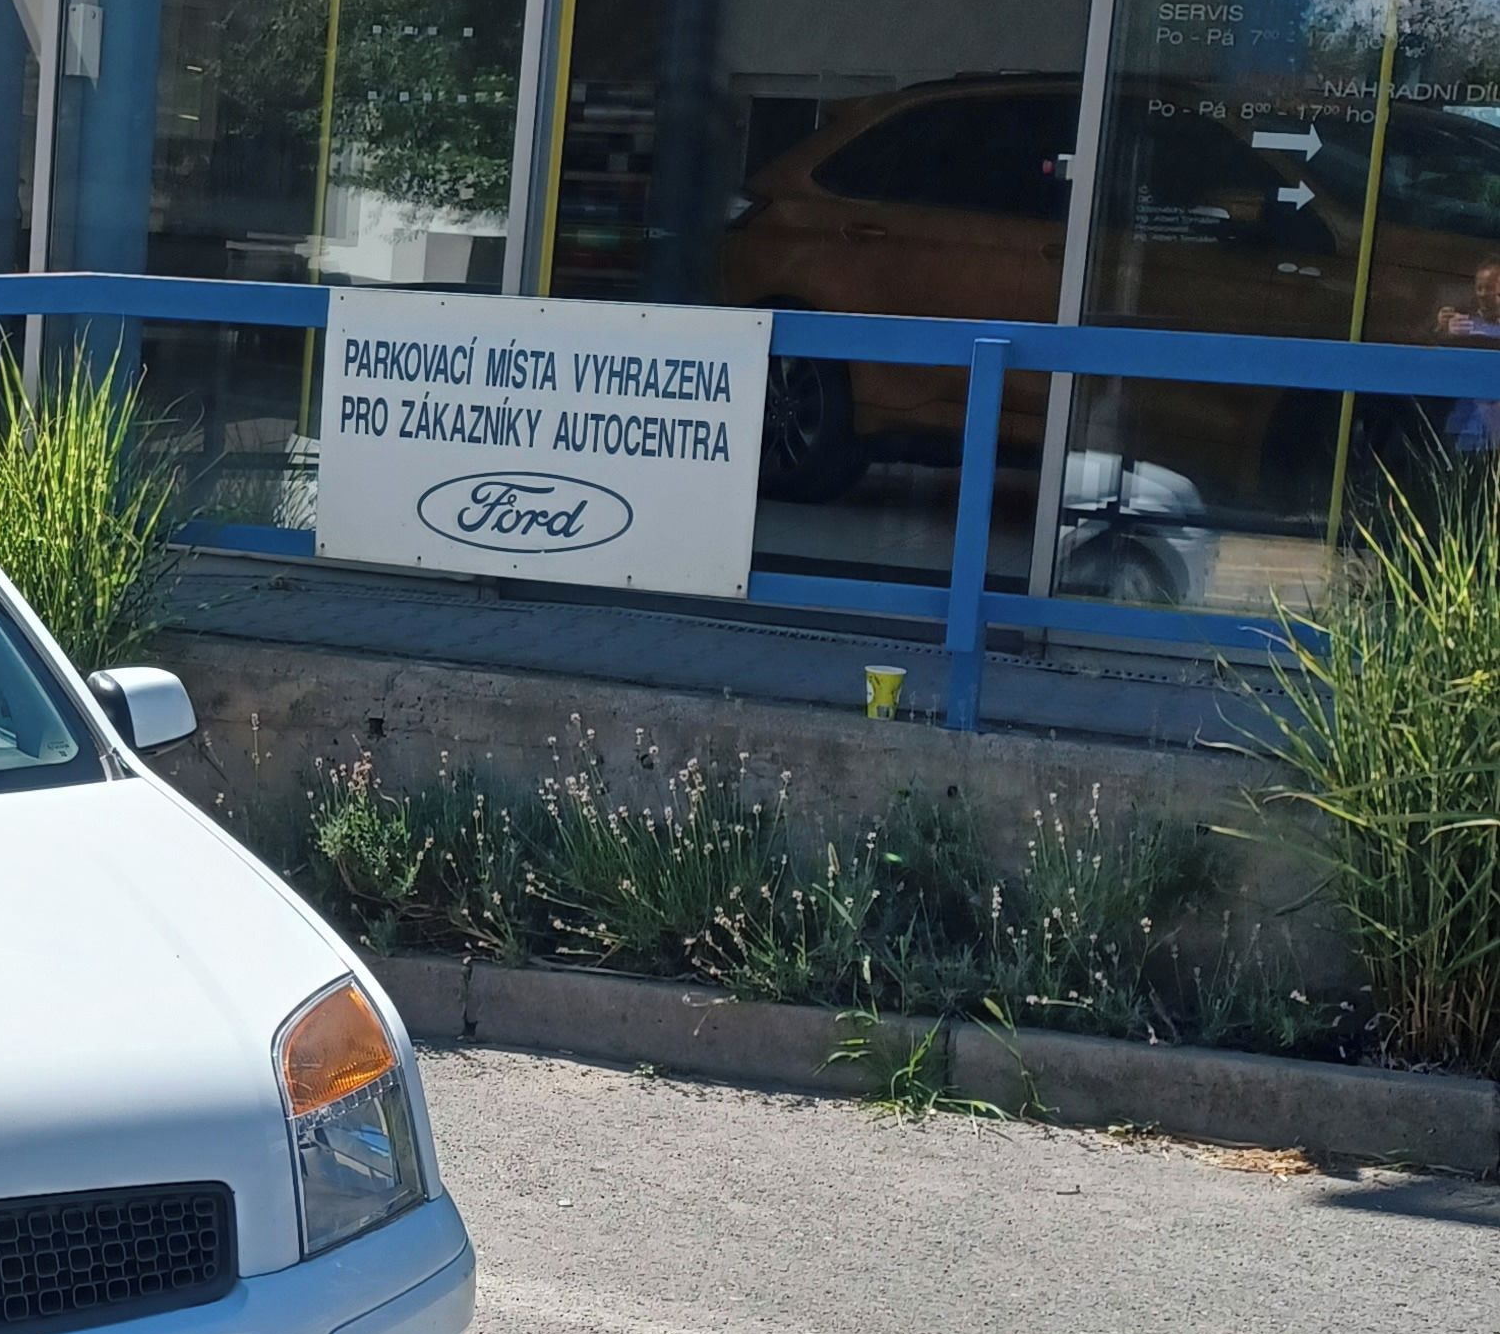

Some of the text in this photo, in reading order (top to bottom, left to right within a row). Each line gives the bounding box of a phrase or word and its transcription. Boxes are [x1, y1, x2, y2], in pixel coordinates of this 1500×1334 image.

[1158, 4, 1244, 23] SERVIS
[1156, 28, 1184, 46] Po
[1207, 28, 1235, 46] Pá
[1148, 100, 1176, 118] Po
[1199, 100, 1227, 119] Pá
[344, 336, 732, 404] PARKOVACÍ MÍSTA VYHRAZENA
[340, 392, 731, 463] PRO ZÁKAZNÍKY AUTOCENTRA
[457, 481, 589, 539] Ford
